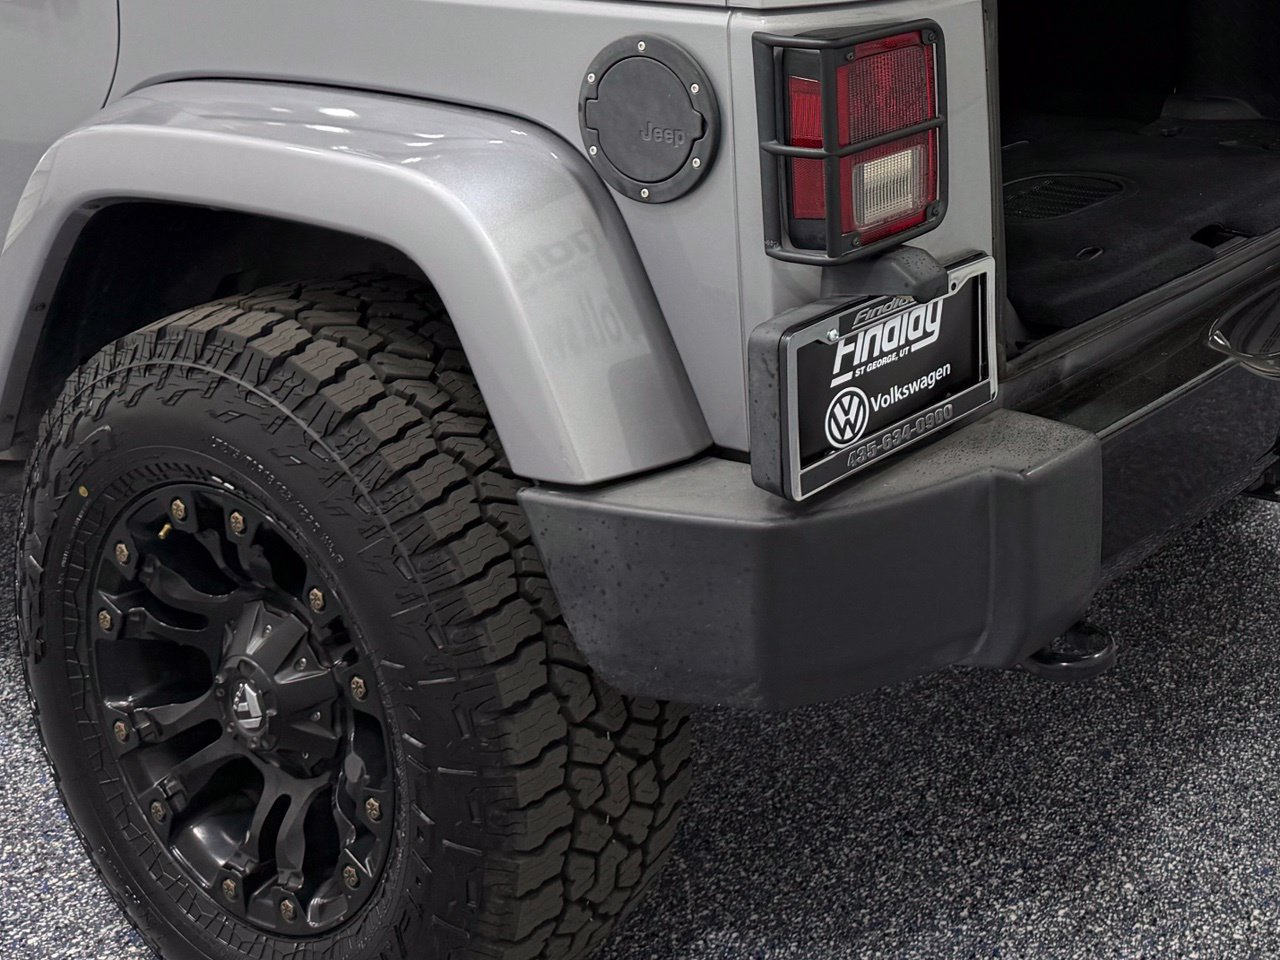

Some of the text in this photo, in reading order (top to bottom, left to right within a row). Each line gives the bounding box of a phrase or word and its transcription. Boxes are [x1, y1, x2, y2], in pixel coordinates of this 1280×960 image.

[640, 121, 686, 147] Jeep
[832, 298, 944, 376] Findlay
[854, 346, 911, 378] ST GEORGE, UT
[870, 363, 951, 412] Volkswagen
